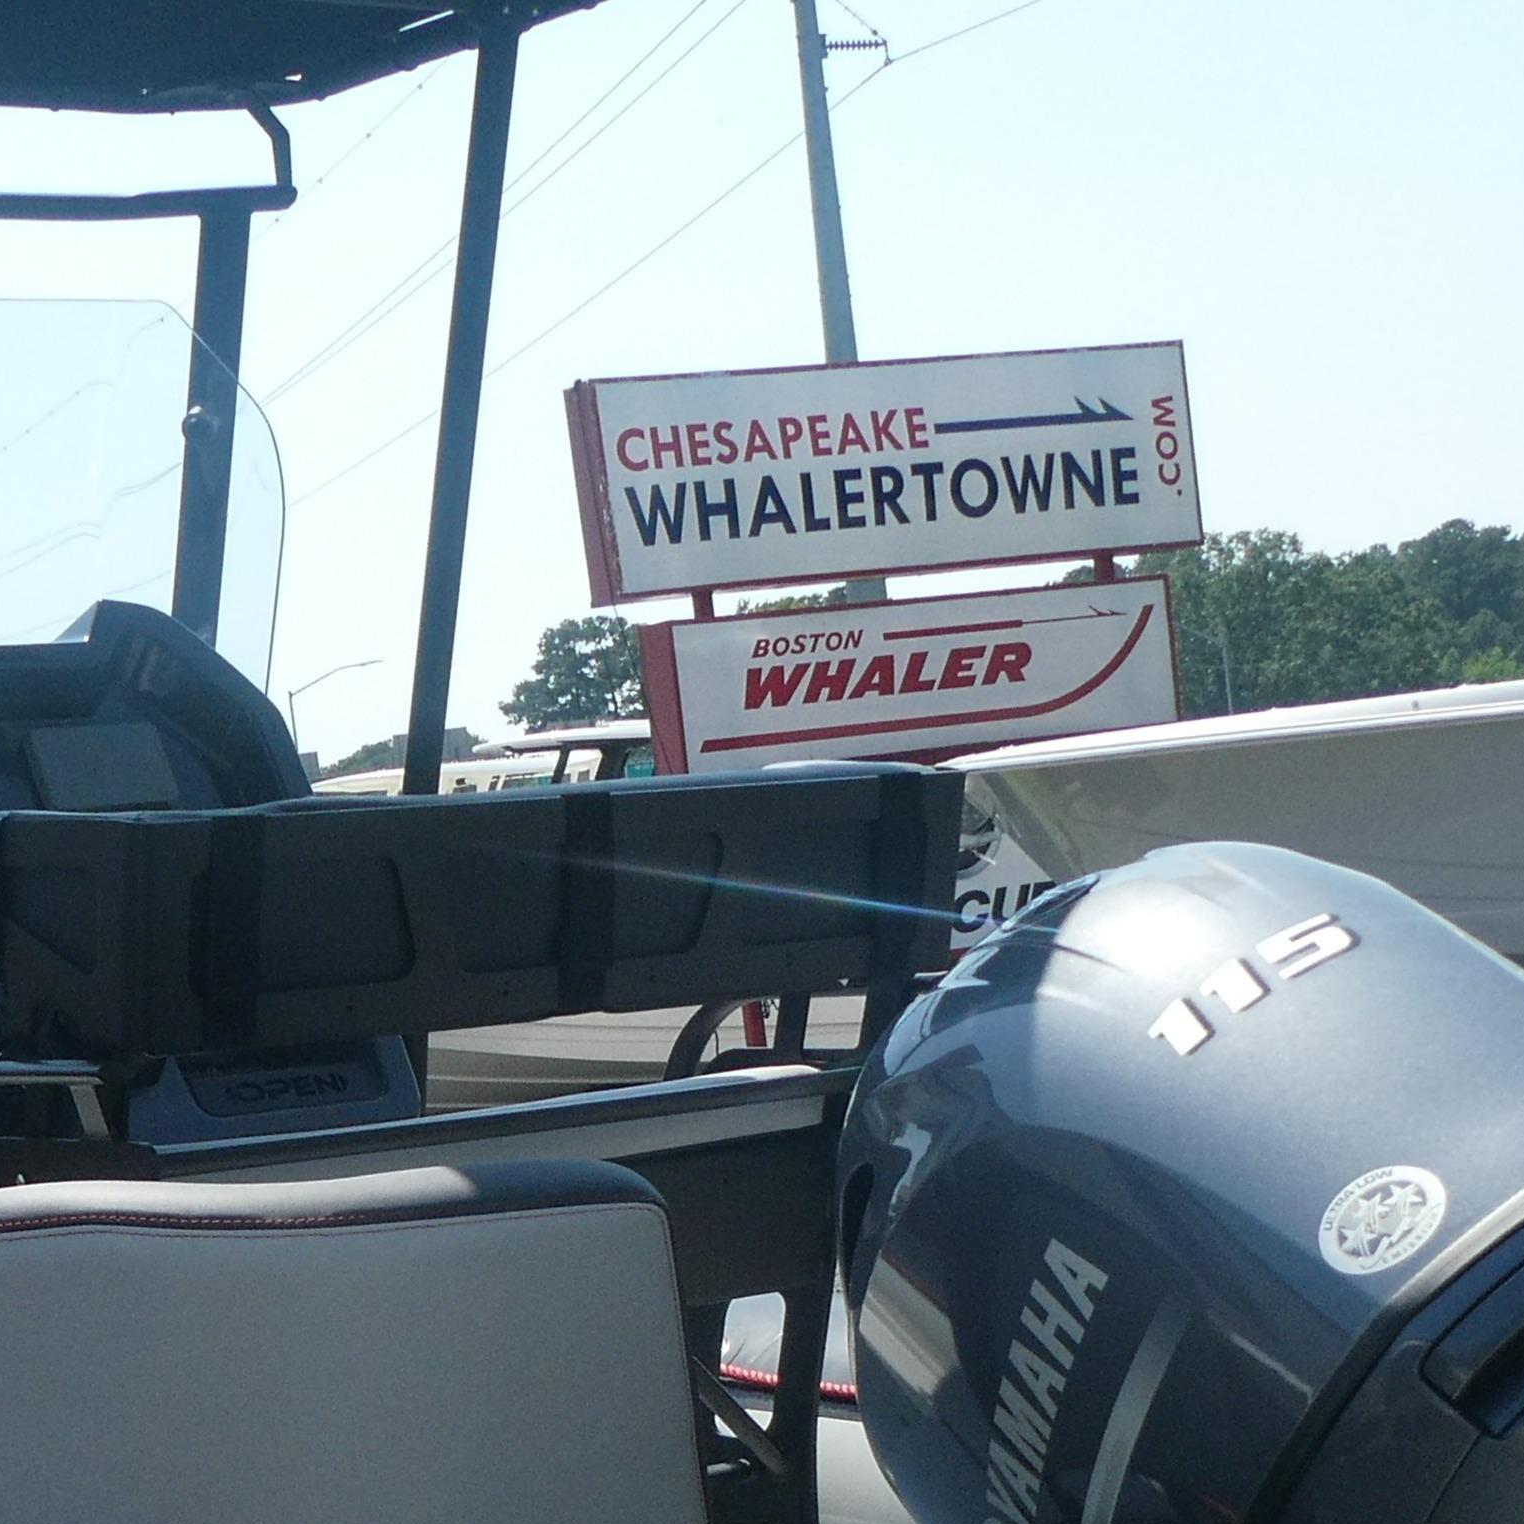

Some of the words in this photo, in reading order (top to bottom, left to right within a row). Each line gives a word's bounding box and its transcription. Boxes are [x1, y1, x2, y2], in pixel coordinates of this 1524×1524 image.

[615, 406, 931, 472] CHESAPEAKE
[1155, 395, 1183, 497] .COM
[624, 446, 1140, 546] WHALERTOWNE
[743, 641, 1033, 710] WHALER
[751, 628, 863, 659] BOSTON
[1147, 912, 1362, 1057] 115
